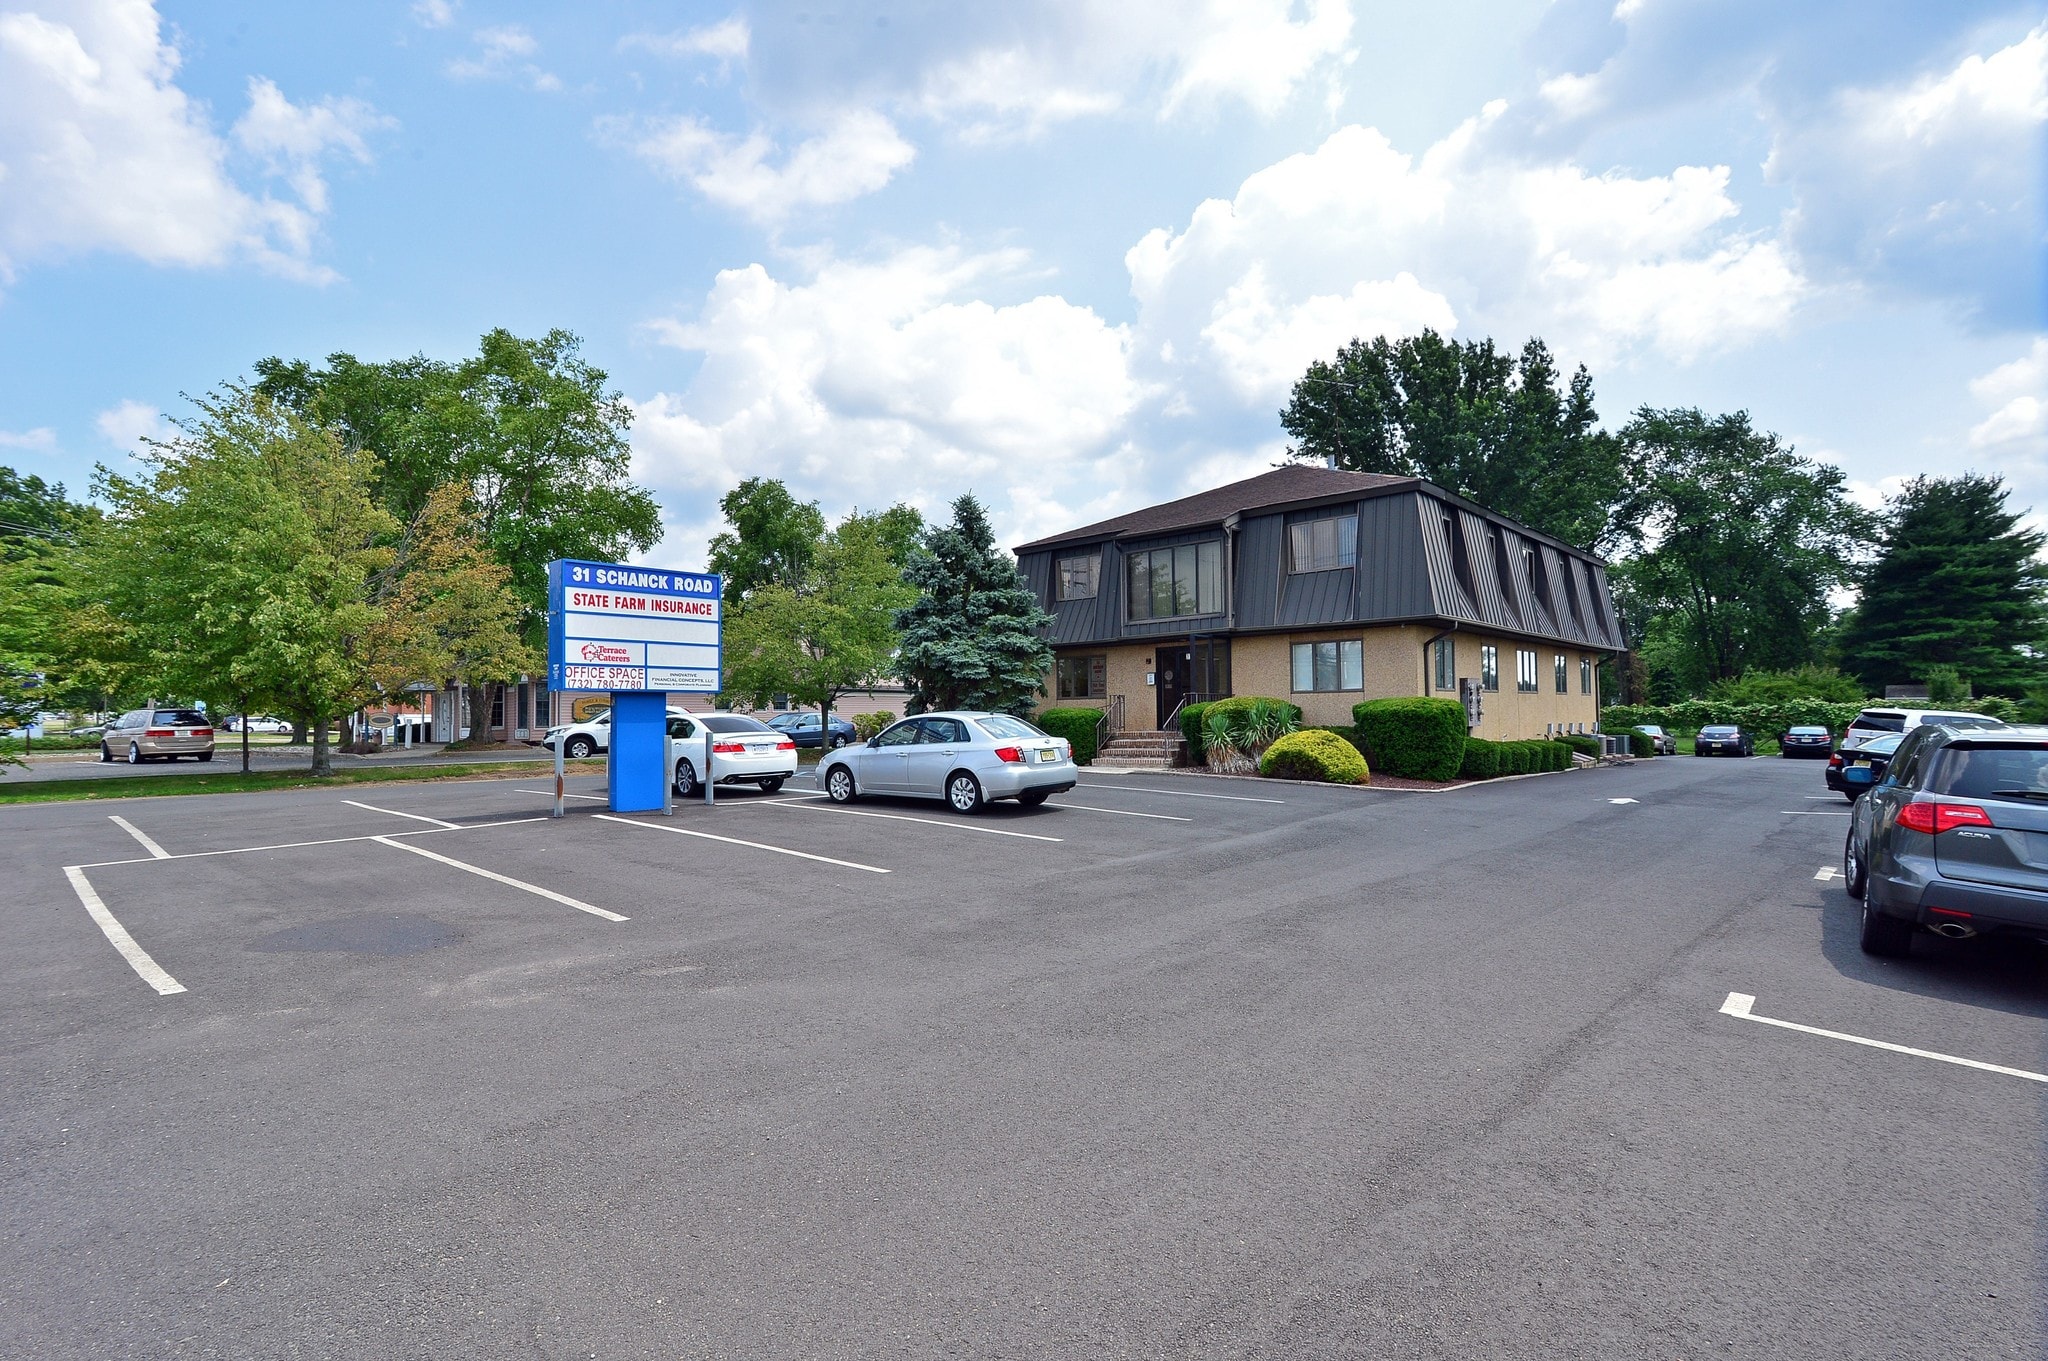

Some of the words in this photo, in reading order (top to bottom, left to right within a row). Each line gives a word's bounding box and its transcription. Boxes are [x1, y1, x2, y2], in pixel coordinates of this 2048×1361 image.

[572, 566, 590, 582] 31
[596, 569, 669, 590] SCHANCK
[674, 577, 713, 593] ROAD
[573, 592, 609, 608] STATE
[615, 596, 646, 611] FARM
[651, 599, 712, 616] INSURANCE
[598, 646, 627, 654] Terrace
[597, 653, 631, 662] Caterers
[565, 666, 605, 678] OFFICE
[609, 667, 644, 679] SPACE
[567, 679, 593, 689] (732)
[596, 679, 642, 690] 780-7780
[1957, 831, 1991, 840] ACURA
